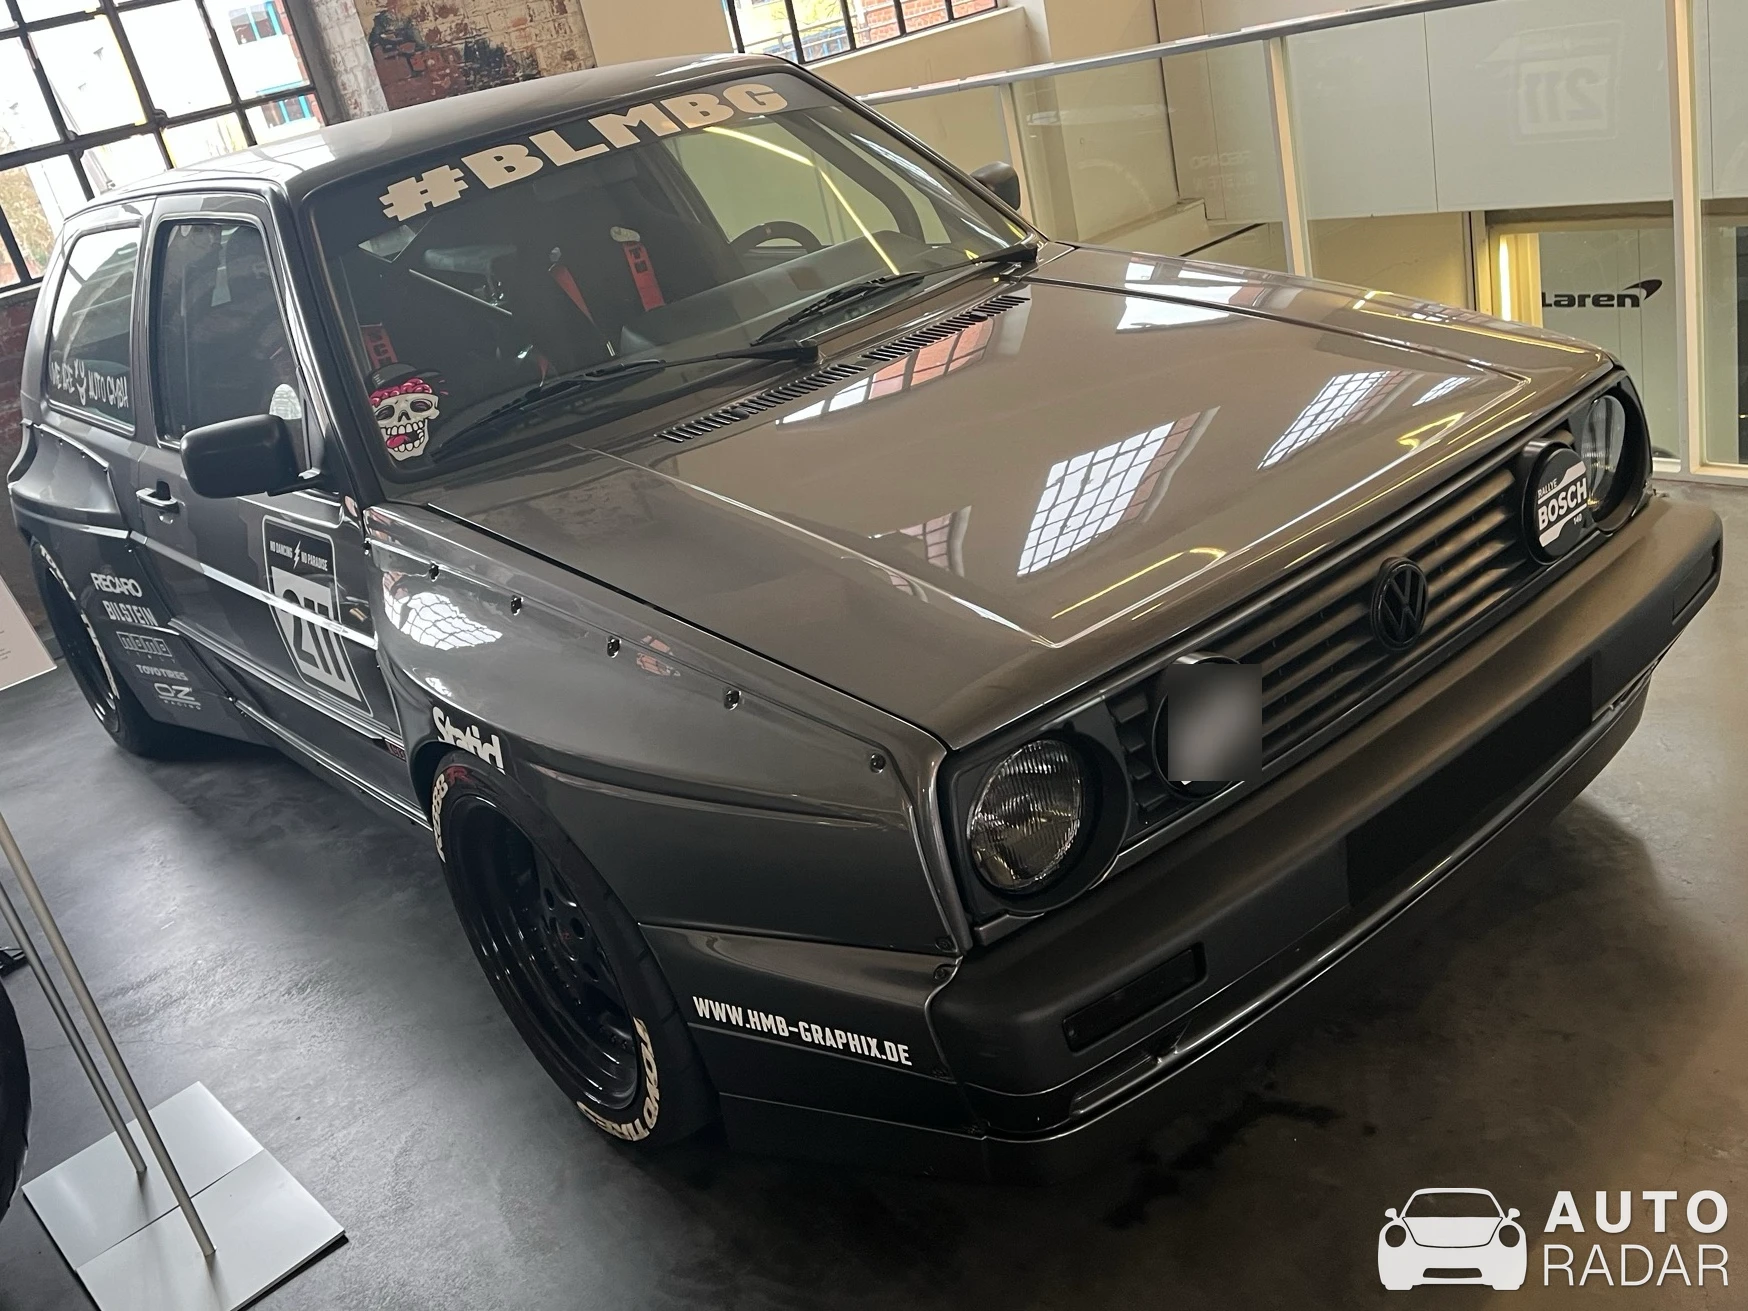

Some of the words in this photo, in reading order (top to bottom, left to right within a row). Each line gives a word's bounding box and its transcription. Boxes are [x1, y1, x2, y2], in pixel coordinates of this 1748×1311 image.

[379, 84, 788, 222] #BLMBG
[1537, 478, 1558, 498] RALLYE
[1538, 477, 1587, 531] BOSCH
[90, 572, 143, 598] RECARO
[102, 600, 159, 627] BILSTEIN
[283, 589, 347, 682] 211
[692, 995, 913, 1067] WWW.HMB-GRAPHIX.DE
[632, 1016, 660, 1130] TOYO
